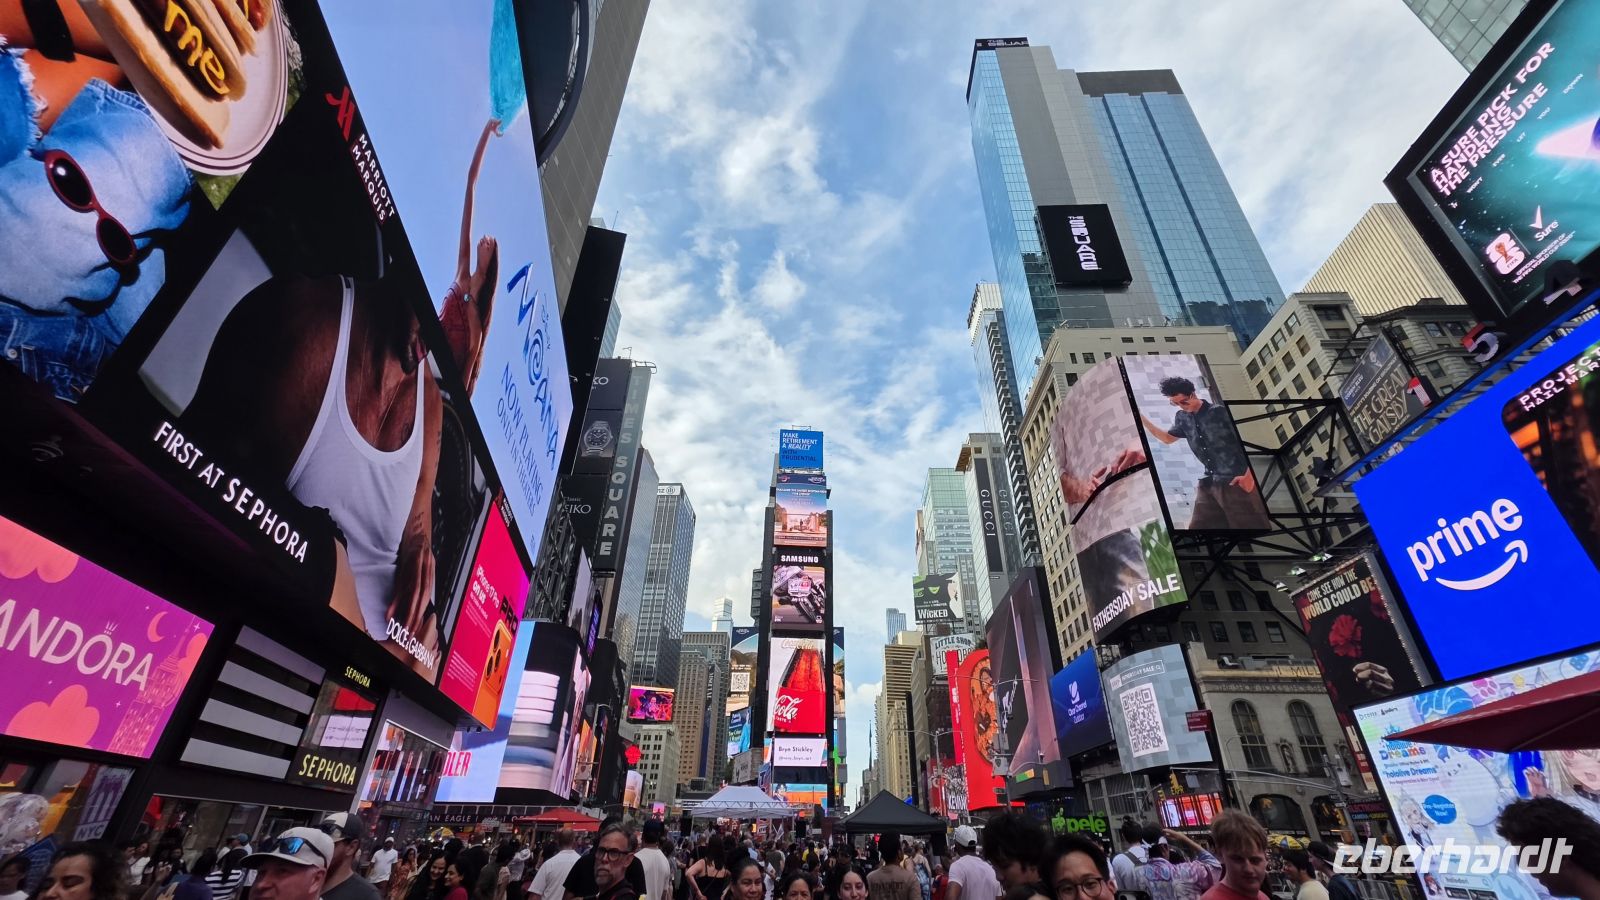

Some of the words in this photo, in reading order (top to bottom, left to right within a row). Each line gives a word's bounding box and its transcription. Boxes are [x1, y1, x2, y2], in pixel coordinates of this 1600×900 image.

[1431, 168, 1443, 182] A
[1441, 125, 1479, 169] SURE
[1477, 82, 1518, 127] PICK
[1515, 42, 1556, 84] FOR
[1440, 165, 1470, 196] THE
[1468, 82, 1548, 168] PRESSURE
[357, 133, 396, 218] MARRIOTT
[1434, 105, 1512, 190] HANDLING
[352, 145, 387, 222] MARQUIS
[1534, 219, 1560, 242] Sure
[620, 376, 643, 443] TIMES
[1353, 404, 1375, 434] THE
[1371, 363, 1408, 414] GREAT
[1523, 386, 1565, 412] HAIL
[1565, 357, 1600, 385] MAR
[497, 398, 514, 444] ONLY
[510, 439, 519, 464] IN
[501, 362, 523, 429] NOW
[519, 423, 543, 505] PLAYING
[1368, 389, 1408, 445] GATSBY
[153, 421, 204, 479] FIRST
[197, 461, 225, 489] AT
[222, 478, 309, 564] SEPHORA
[599, 456, 628, 555] SQUARE
[980, 489, 996, 537] GUCCI
[780, 554, 819, 563] SAMSUNG
[1406, 498, 1523, 582] prime
[1092, 588, 1134, 633] FATHERSDAY
[1136, 573, 1181, 601] SALE
[1301, 597, 1332, 621] WORLD
[1331, 583, 1361, 608] COULD
[1361, 576, 1376, 595] BE
[1306, 588, 1322, 603] COME
[1320, 582, 1333, 596] SEE
[1333, 575, 1346, 593] HOW
[1345, 568, 1358, 584] THE
[935, 637, 955, 649] LITTLE
[956, 636, 972, 647] SHOP
[344, 666, 371, 688] SEPHORA
[774, 695, 803, 720] Cola
[298, 754, 356, 786] SEPHORA
[1379, 747, 1426, 761] Dreams
[77, 825, 102, 839] NYC
